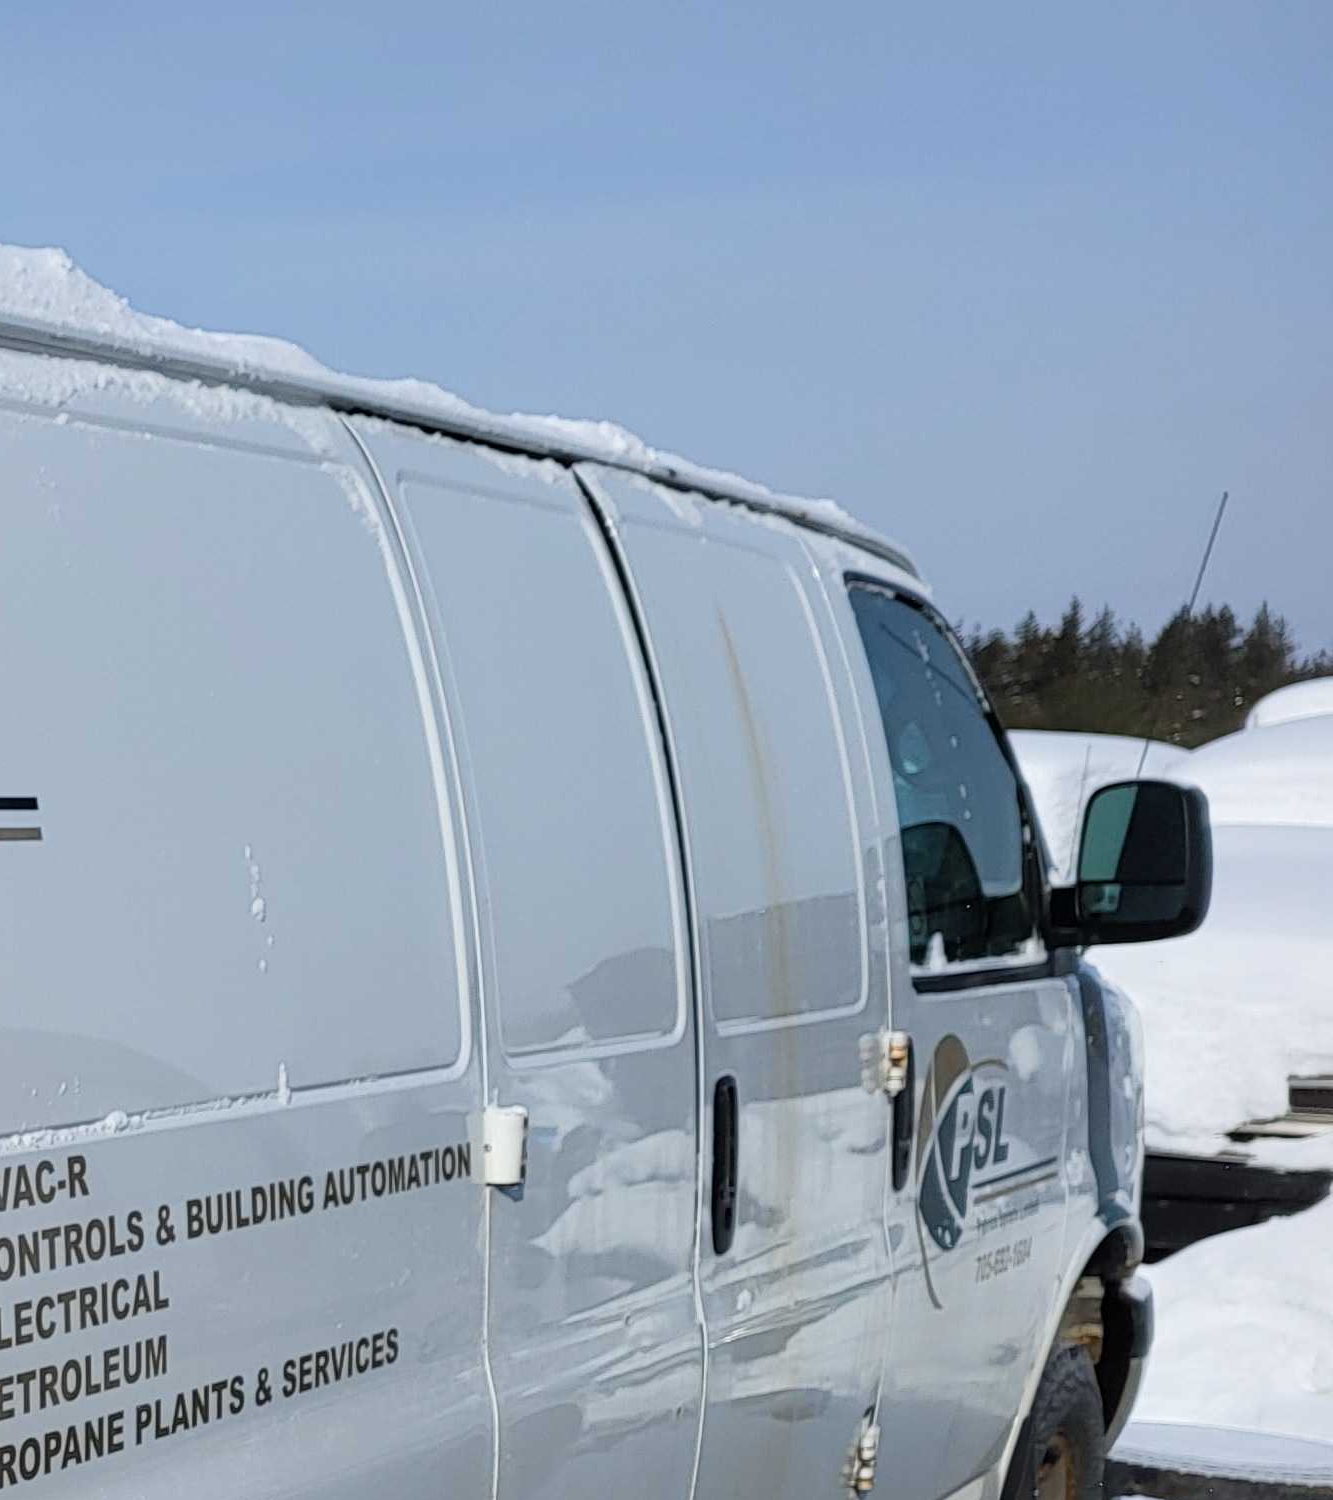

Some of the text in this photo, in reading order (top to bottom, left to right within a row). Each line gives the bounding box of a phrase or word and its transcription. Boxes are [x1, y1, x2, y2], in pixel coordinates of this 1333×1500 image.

[951, 1086, 1009, 1181] PSL
[155, 1205, 176, 1245] &
[186, 1176, 314, 1239] BUILDING
[323, 1142, 471, 1210] AUTOMATION
[135, 1374, 245, 1445] PLANTS
[254, 1367, 273, 1407] &
[282, 1328, 400, 1398] SERVICES
